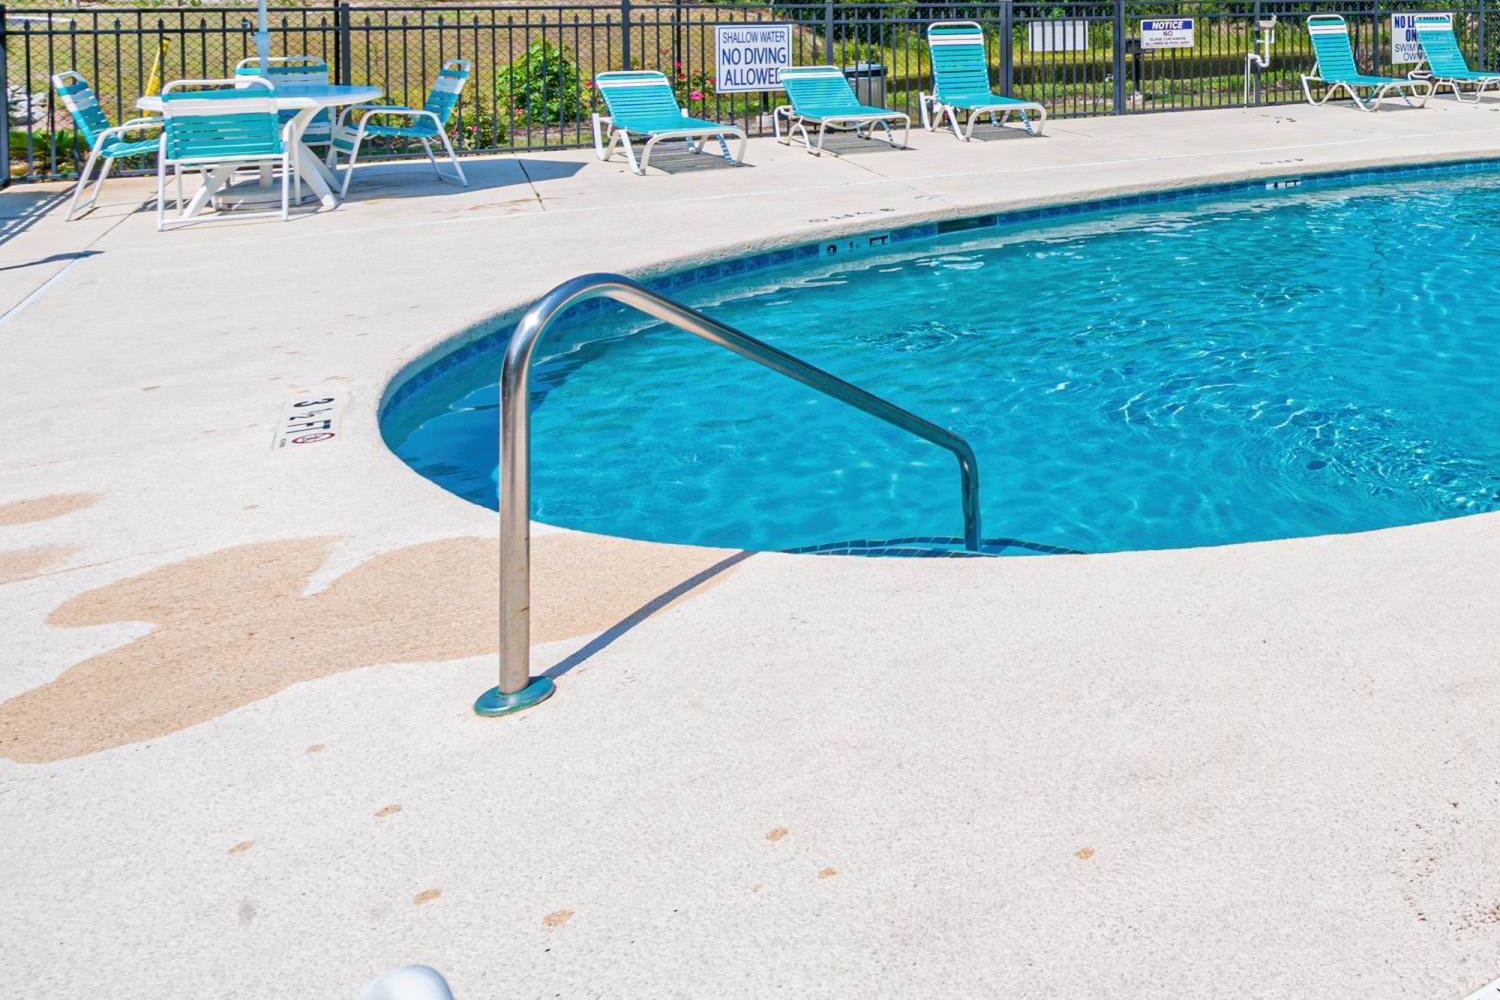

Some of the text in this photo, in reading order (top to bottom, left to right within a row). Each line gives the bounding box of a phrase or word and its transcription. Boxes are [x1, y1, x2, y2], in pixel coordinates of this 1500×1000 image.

[1152, 21, 1184, 30] NOTICE
[1394, 15, 1406, 28] NO
[722, 30, 786, 44] SHALLOW WATER
[1405, 29, 1417, 42] ON
[1394, 43, 1416, 53] SWIM
[722, 46, 786, 66] NO DIVING
[1403, 52, 1423, 61] OWN
[293, 397, 335, 408] 3
[286, 419, 332, 434] FT
